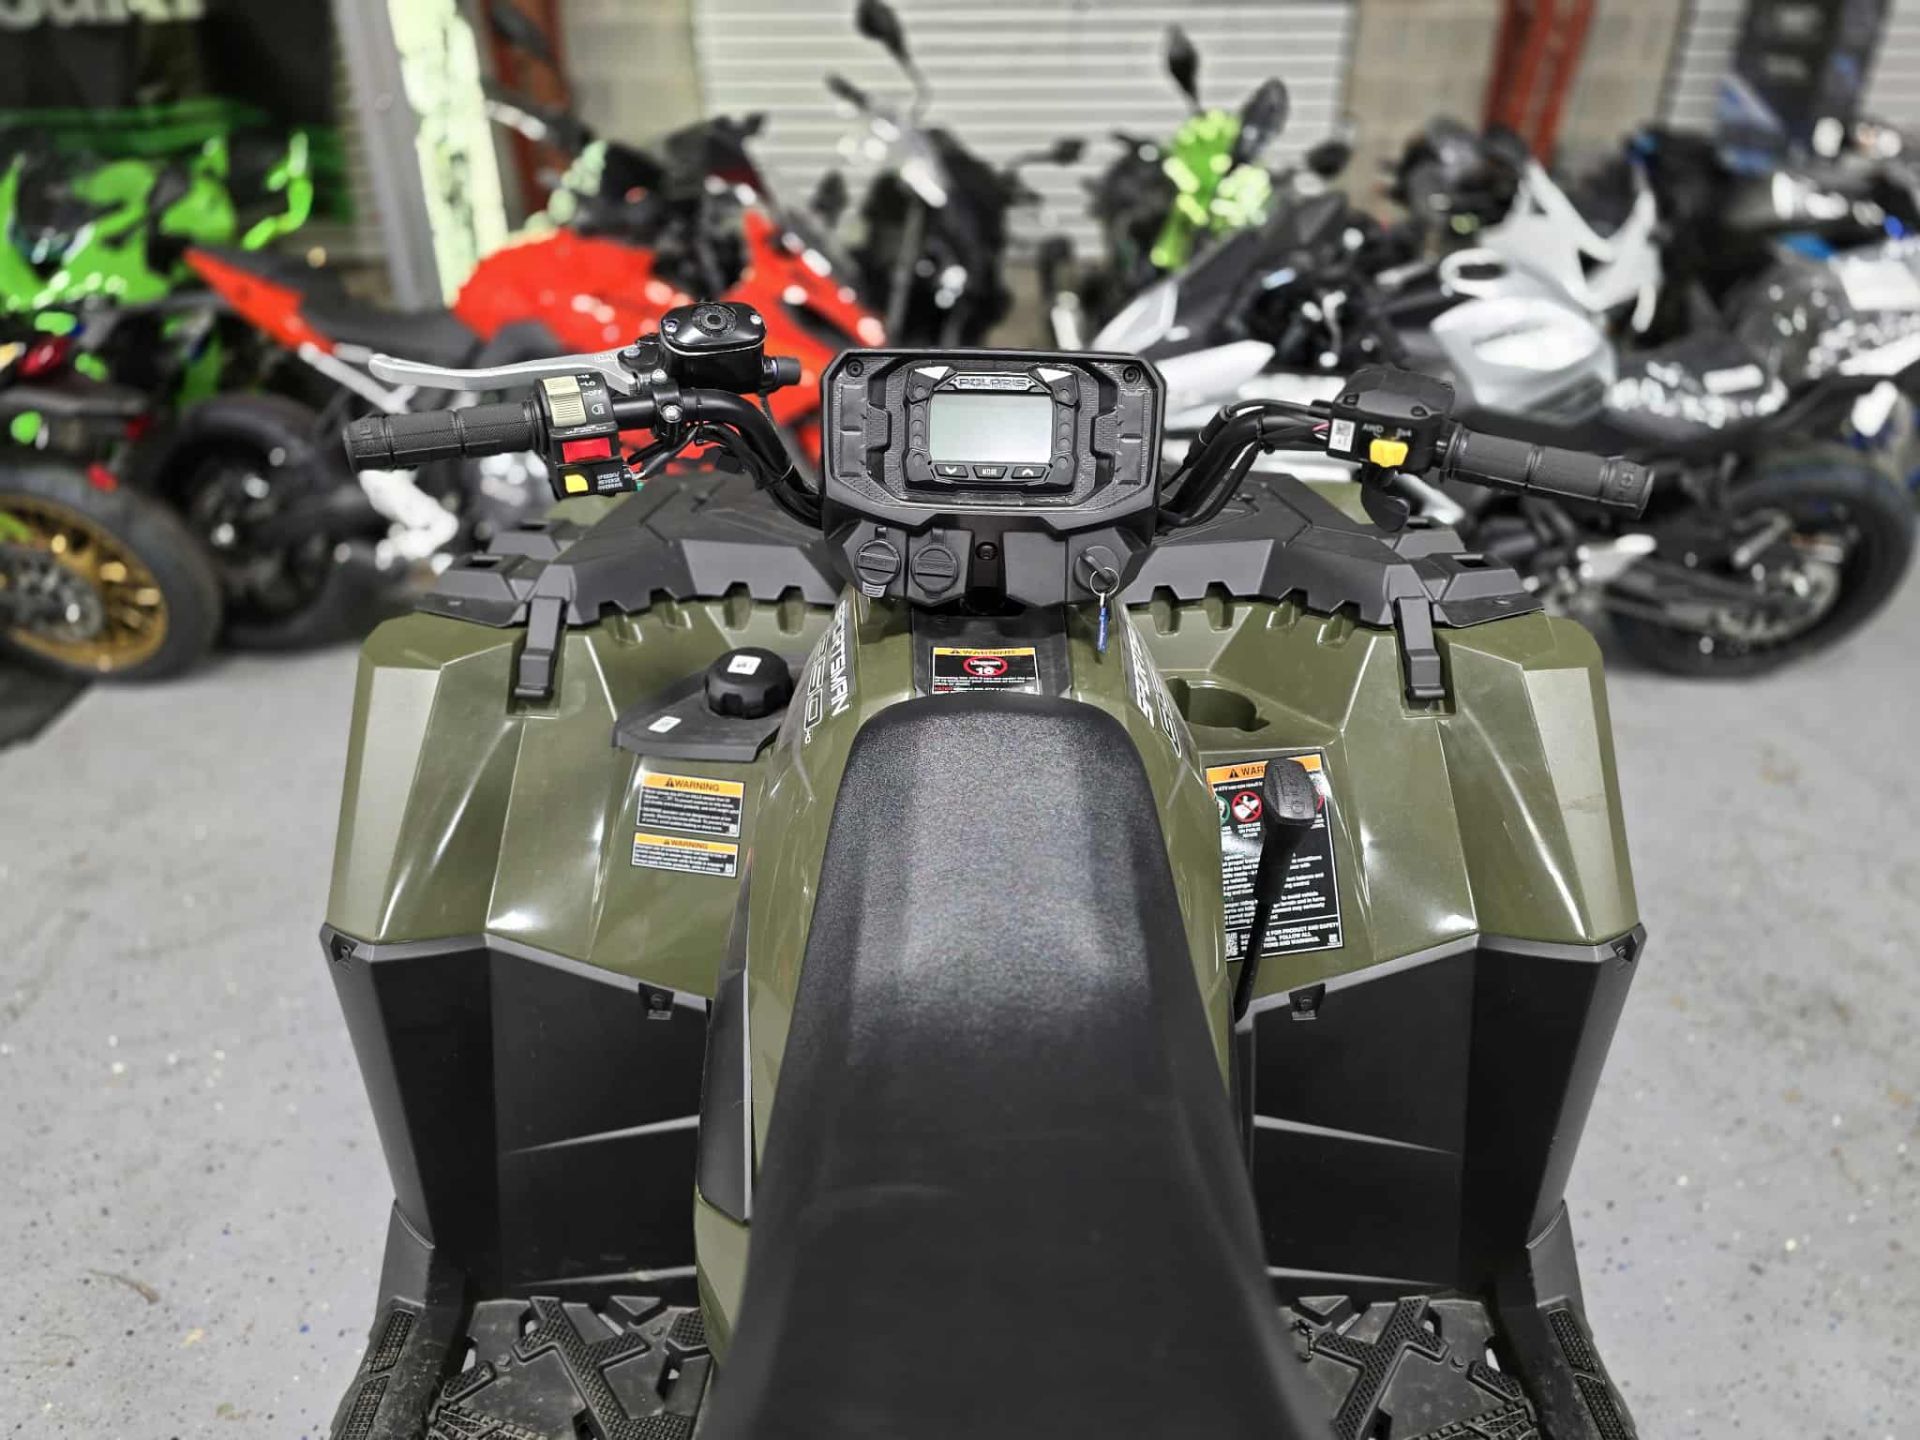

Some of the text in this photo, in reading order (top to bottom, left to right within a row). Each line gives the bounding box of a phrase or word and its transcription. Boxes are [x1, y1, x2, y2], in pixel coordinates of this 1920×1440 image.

[959, 378, 1028, 389] POLARIS
[675, 779, 720, 792] WARNING
[671, 838, 709, 849] WARNING
